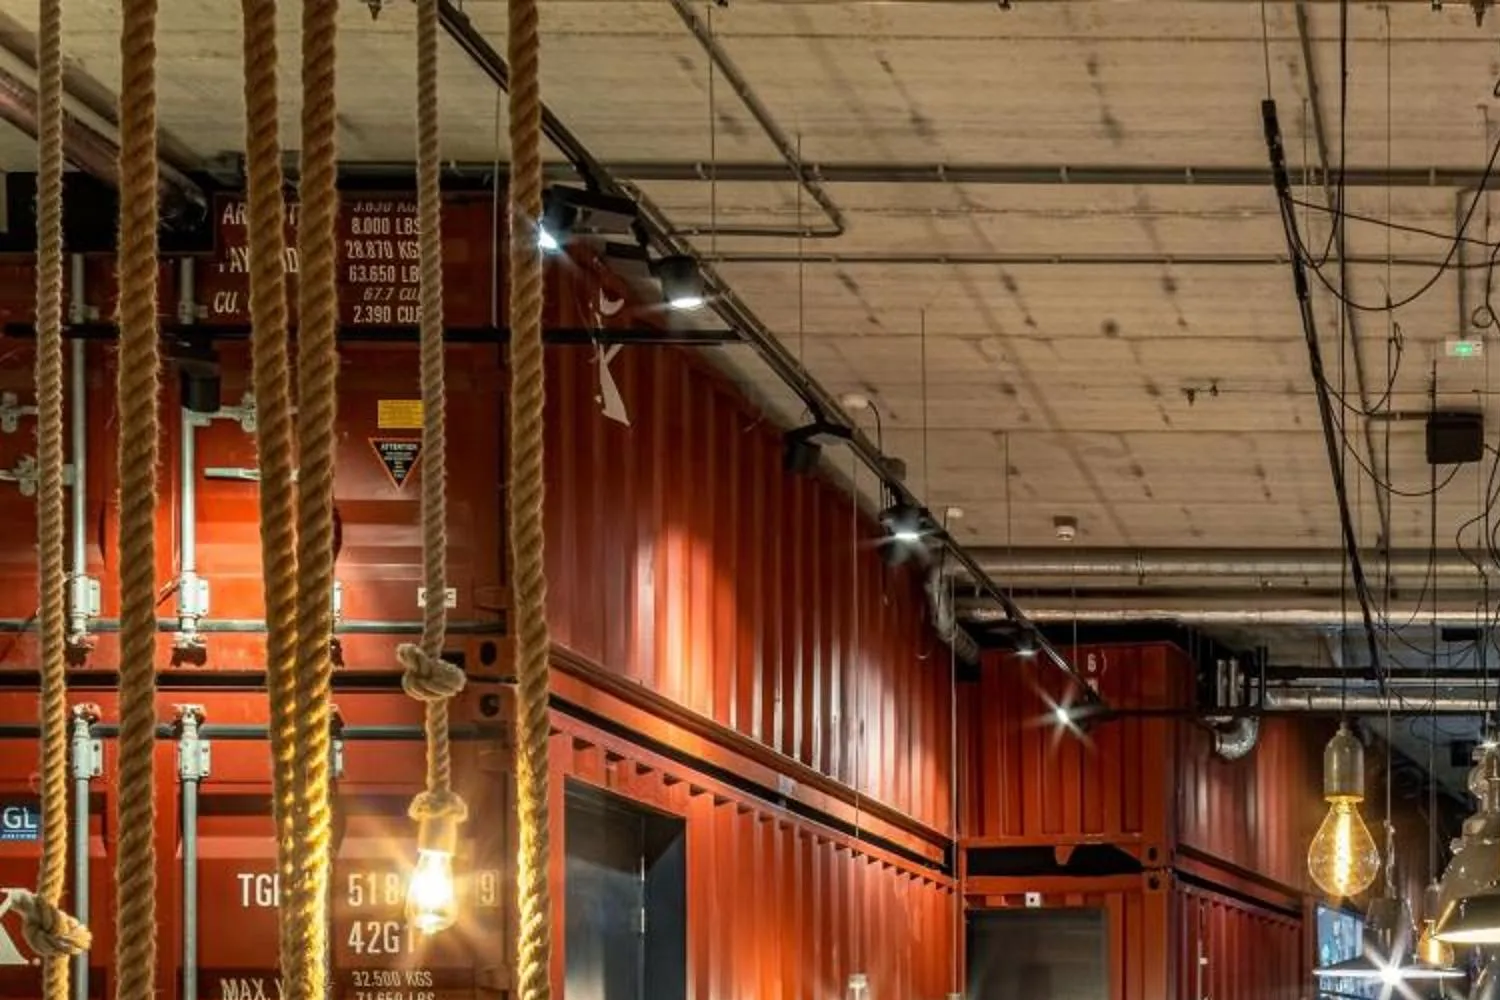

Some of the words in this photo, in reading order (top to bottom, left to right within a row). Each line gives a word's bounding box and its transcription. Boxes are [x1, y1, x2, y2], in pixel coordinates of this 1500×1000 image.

[352, 217, 391, 235] 8.000
[402, 265, 421, 283] LB
[353, 305, 391, 323] 2.390
[3, 807, 37, 829] GL
